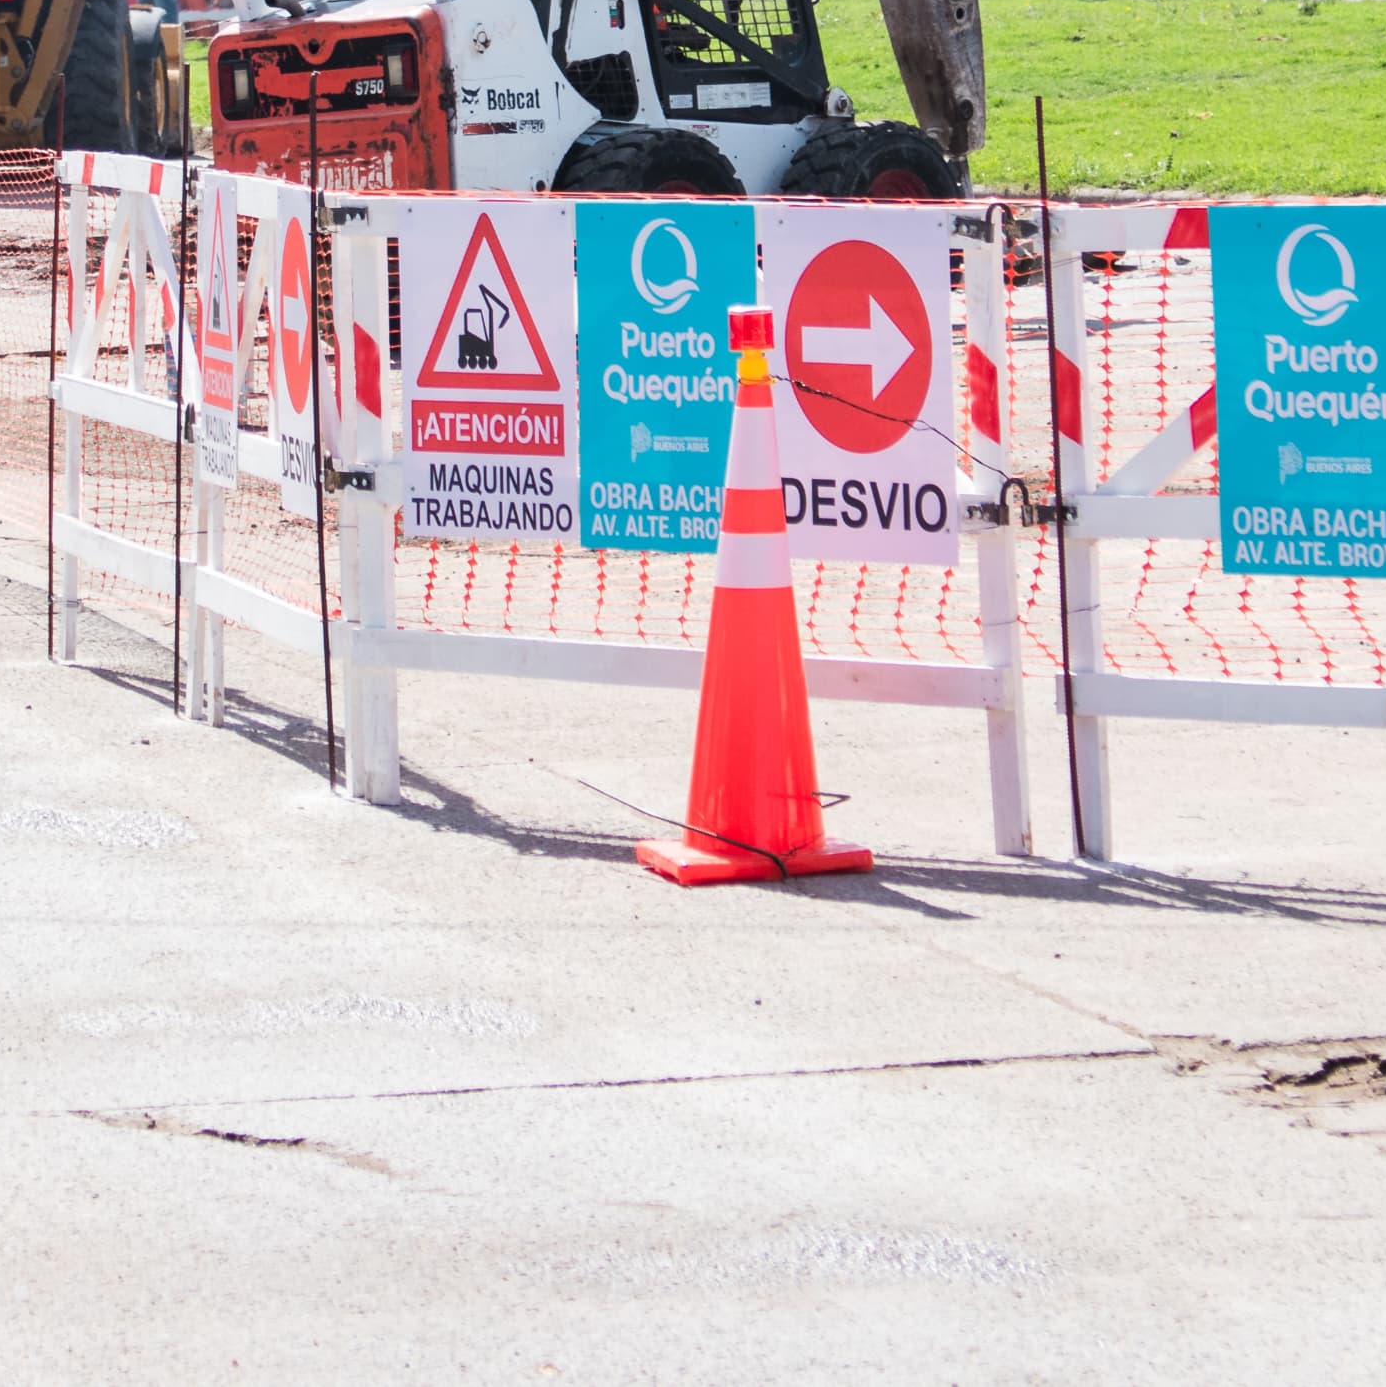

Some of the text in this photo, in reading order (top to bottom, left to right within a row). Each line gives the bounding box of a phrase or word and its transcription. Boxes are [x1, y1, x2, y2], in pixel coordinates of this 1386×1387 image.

[355, 79, 384, 95] S750
[486, 87, 541, 111] Bobcat
[621, 322, 714, 359] Puerto
[1264, 334, 1378, 374] Puerto
[603, 364, 735, 408] Quequén
[417, 407, 558, 447] ¡ATENCIÓN!
[429, 464, 554, 496] MAQUINAS
[590, 482, 724, 513] OBRA BACH
[781, 477, 947, 533] DESVIO
[411, 498, 572, 532] TRABAJANDO
[591, 514, 721, 540] AV. ALTE. BRO
[1232, 506, 1307, 537] OBRA
[1235, 540, 1268, 565] AV.
[1274, 541, 1332, 567] ALTE.
